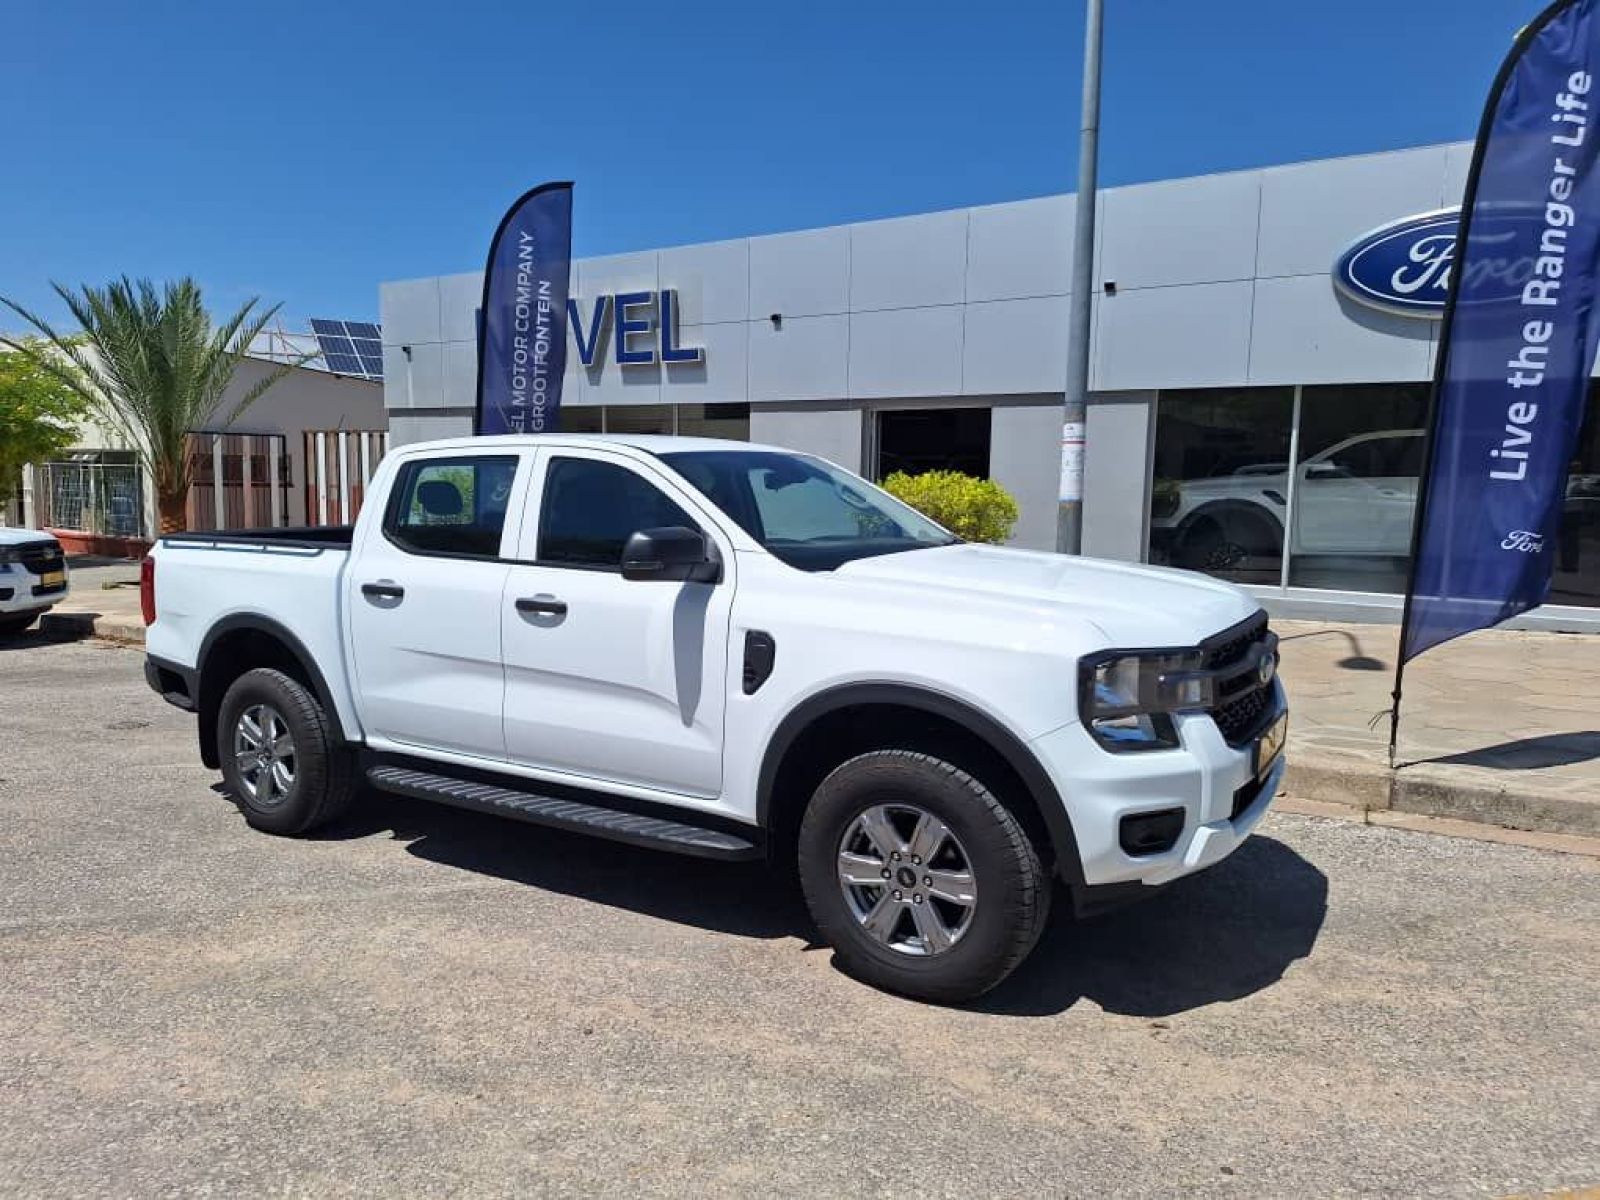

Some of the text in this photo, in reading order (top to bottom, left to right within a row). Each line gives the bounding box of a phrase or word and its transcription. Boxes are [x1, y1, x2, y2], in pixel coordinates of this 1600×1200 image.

[516, 231, 534, 334] COMPANY
[1490, 70, 1592, 481] Live the Ranger Life
[512, 338, 530, 405] MOTOR
[531, 281, 552, 432] GROOTFONTEIN
